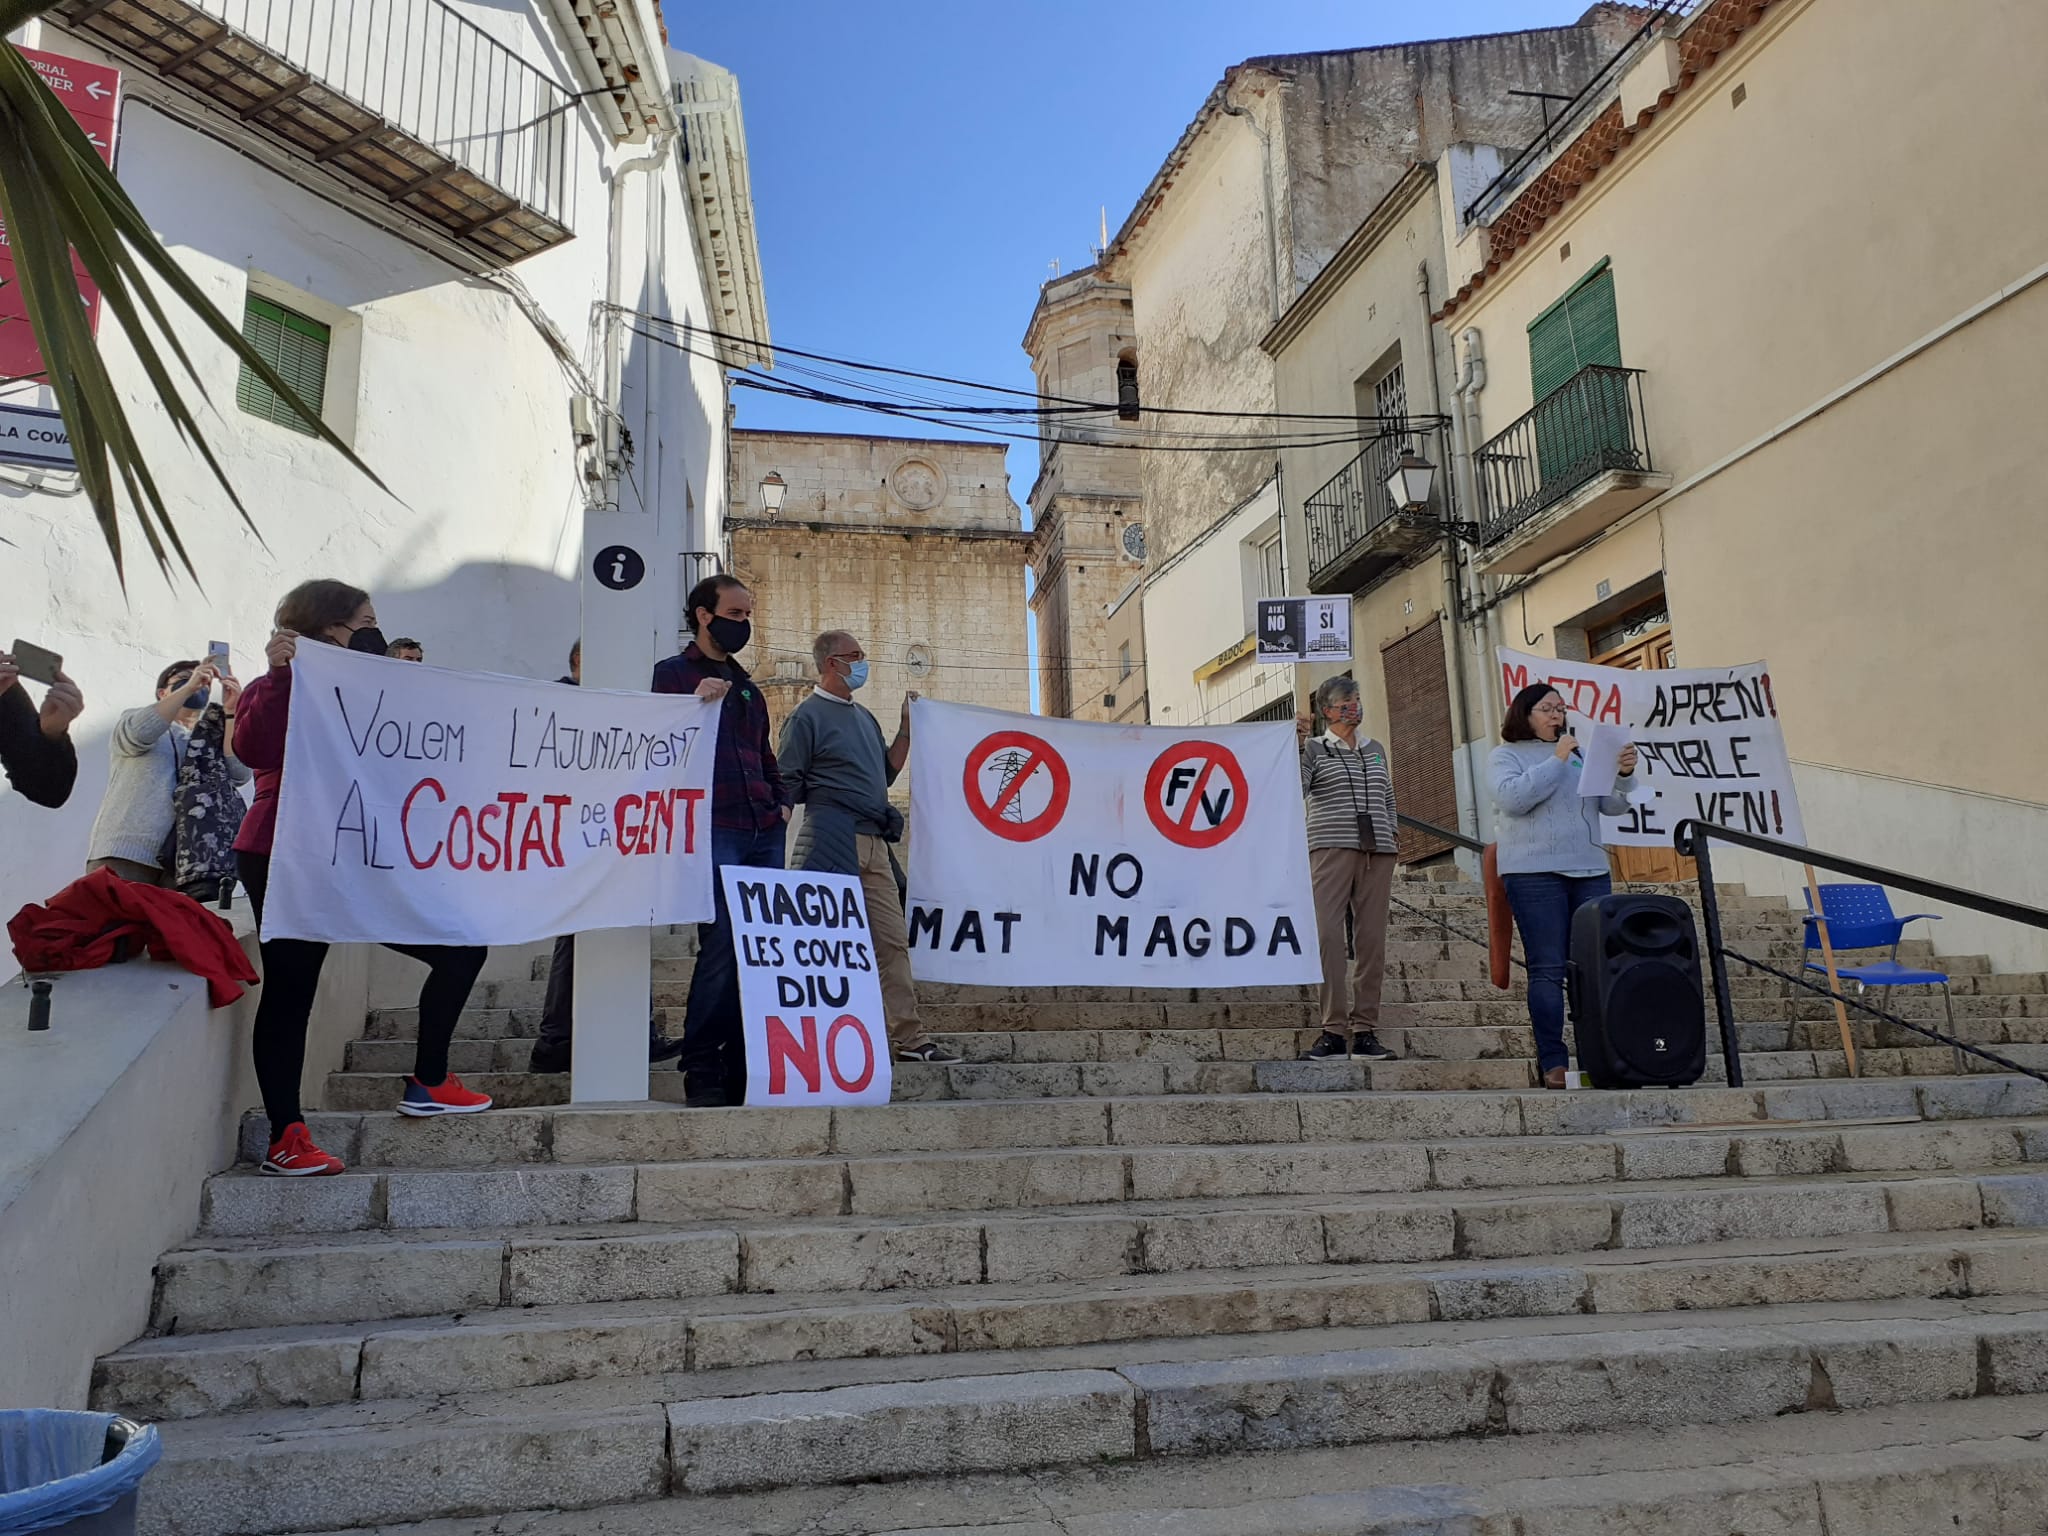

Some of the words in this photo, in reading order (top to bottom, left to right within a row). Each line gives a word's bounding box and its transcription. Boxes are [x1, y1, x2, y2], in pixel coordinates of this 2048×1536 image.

[27, 59, 68, 78] ORIAL
[1267, 615, 1286, 632] NO
[1644, 671, 1777, 728] APRÉN!
[1632, 737, 1760, 779] POBLE
[332, 779, 395, 870] AL
[400, 777, 572, 872] COSTAT
[582, 828, 612, 848] LA
[614, 788, 705, 856] GENT
[1069, 852, 1143, 899] NO
[737, 881, 865, 928] MAGDA
[742, 934, 784, 967] LES
[794, 939, 871, 972] COVES
[909, 906, 1022, 954] MAT
[1094, 915, 1302, 958] MAGDA
[777, 975, 850, 1008] DIU
[765, 1014, 874, 1095] NO
